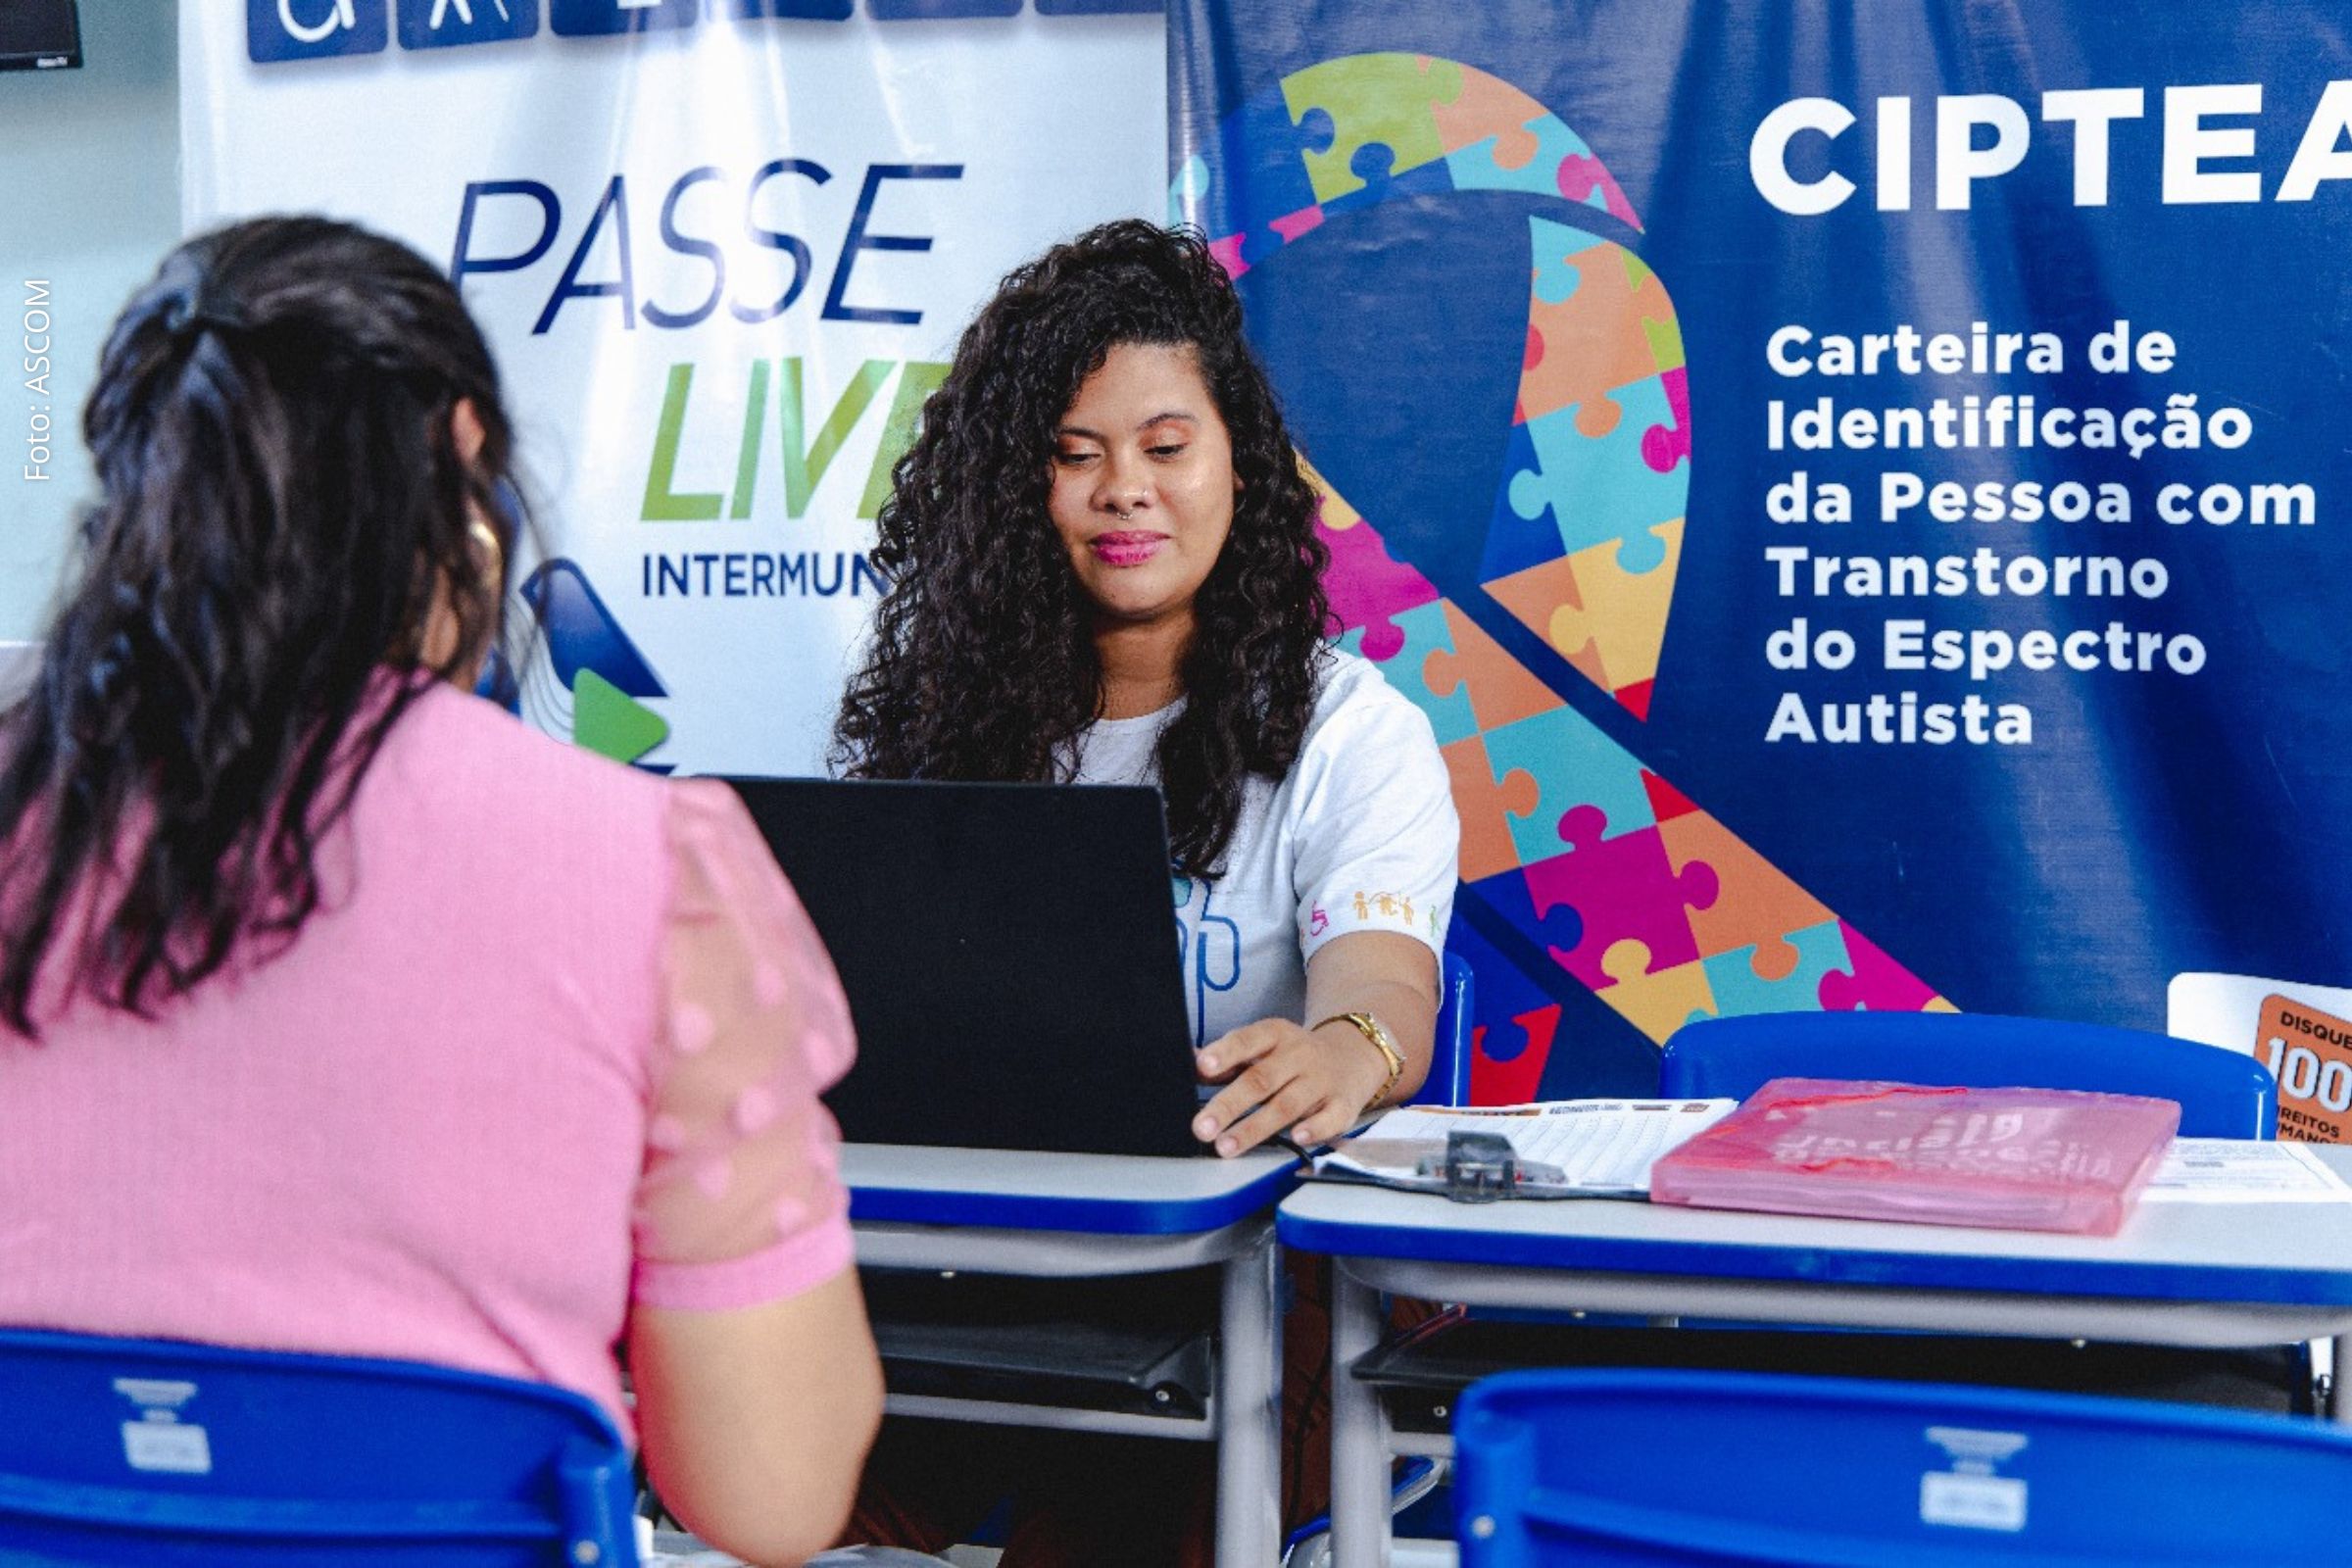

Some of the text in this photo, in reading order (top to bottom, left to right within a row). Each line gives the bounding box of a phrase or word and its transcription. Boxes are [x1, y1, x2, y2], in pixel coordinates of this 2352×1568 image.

[1750, 80, 2352, 215] CIPTEA
[448, 157, 964, 335] PASSE
[1767, 320, 2176, 376] Carteira de
[1768, 394, 2252, 458] Identificação
[1766, 471, 2315, 524] da Pessoa com
[1766, 547, 2168, 598] Transtorno
[1766, 618, 2206, 680] do Espectro
[1766, 692, 2033, 744] Autista
[2280, 1011, 2352, 1050] DISQUE
[2269, 1037, 2352, 1112] 100
